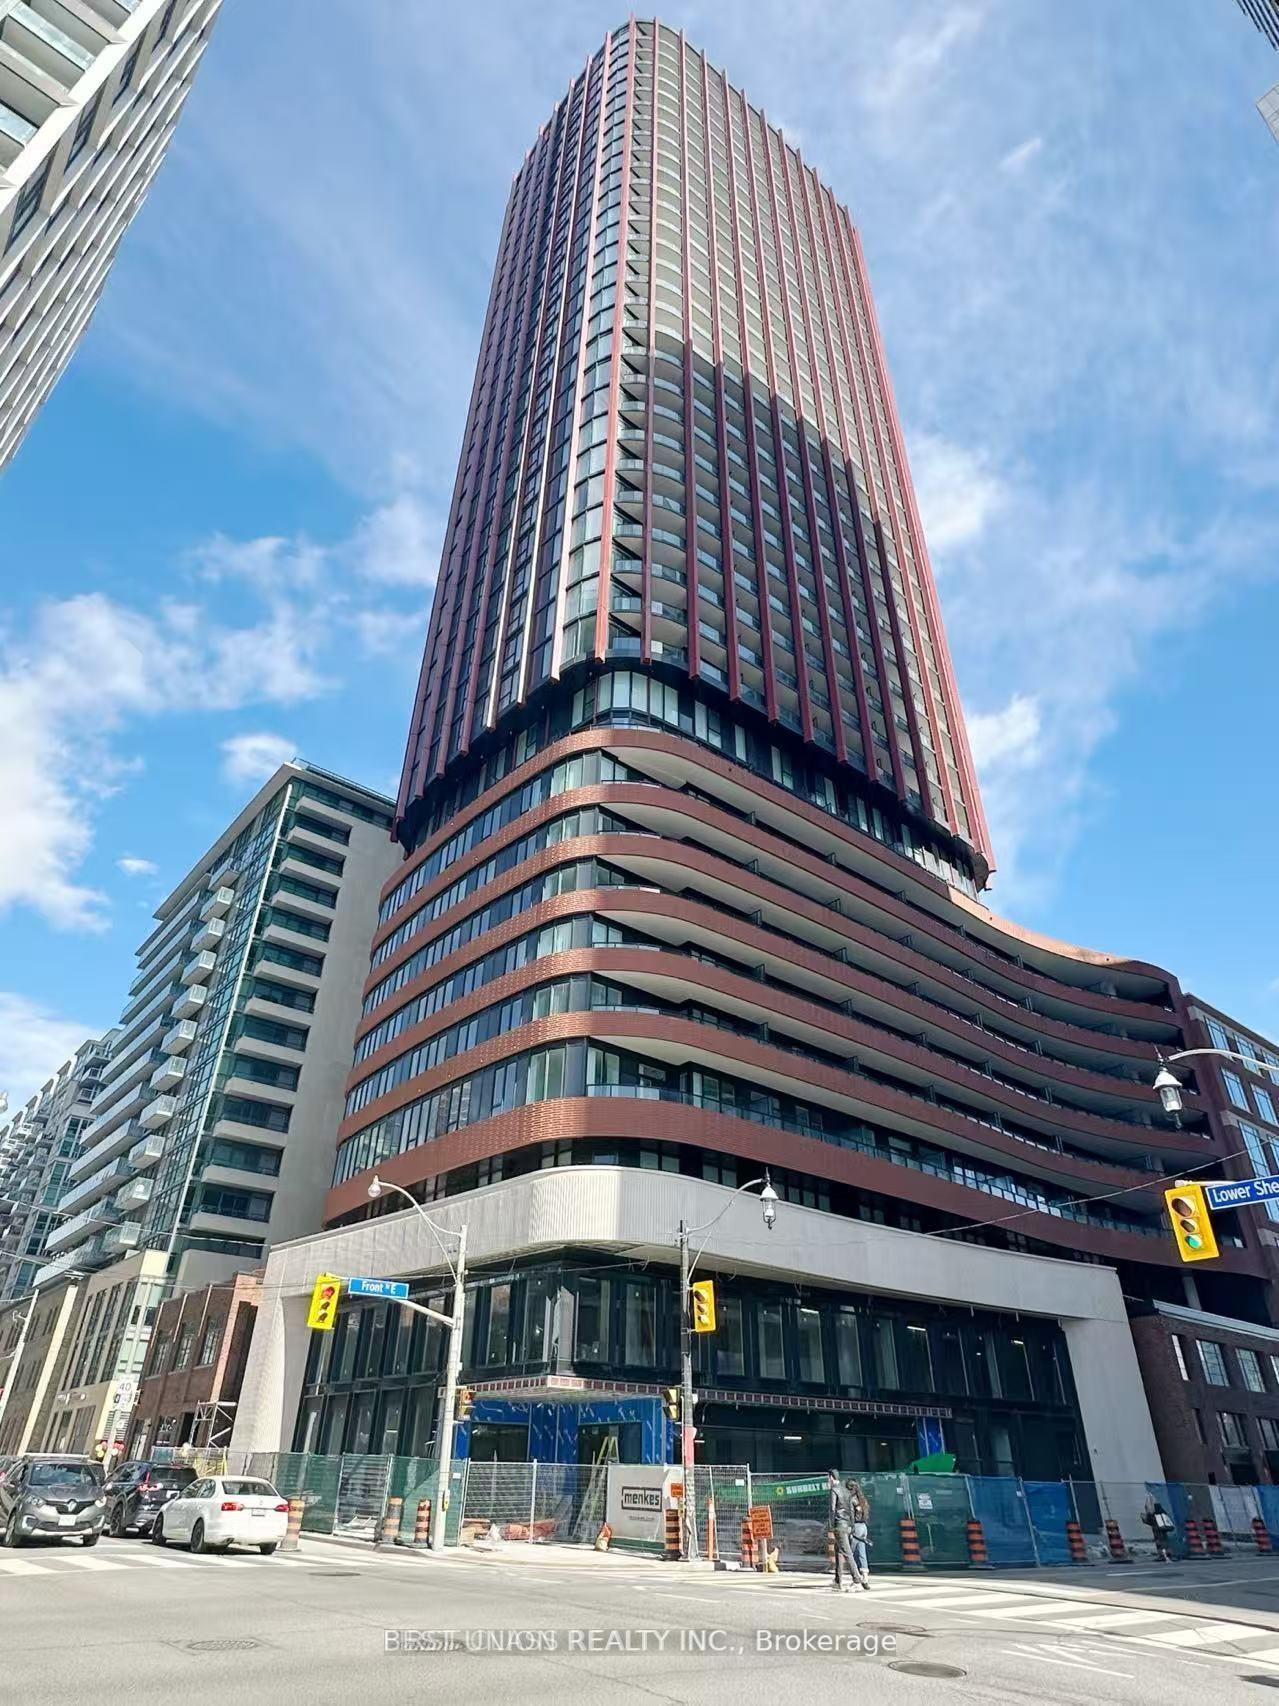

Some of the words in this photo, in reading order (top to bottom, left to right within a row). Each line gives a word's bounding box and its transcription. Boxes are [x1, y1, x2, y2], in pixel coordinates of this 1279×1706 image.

[1212, 1186, 1250, 1203] Lower
[361, 1280, 384, 1293] Front
[119, 1383, 132, 1392] 40
[624, 1490, 660, 1506] menkes
